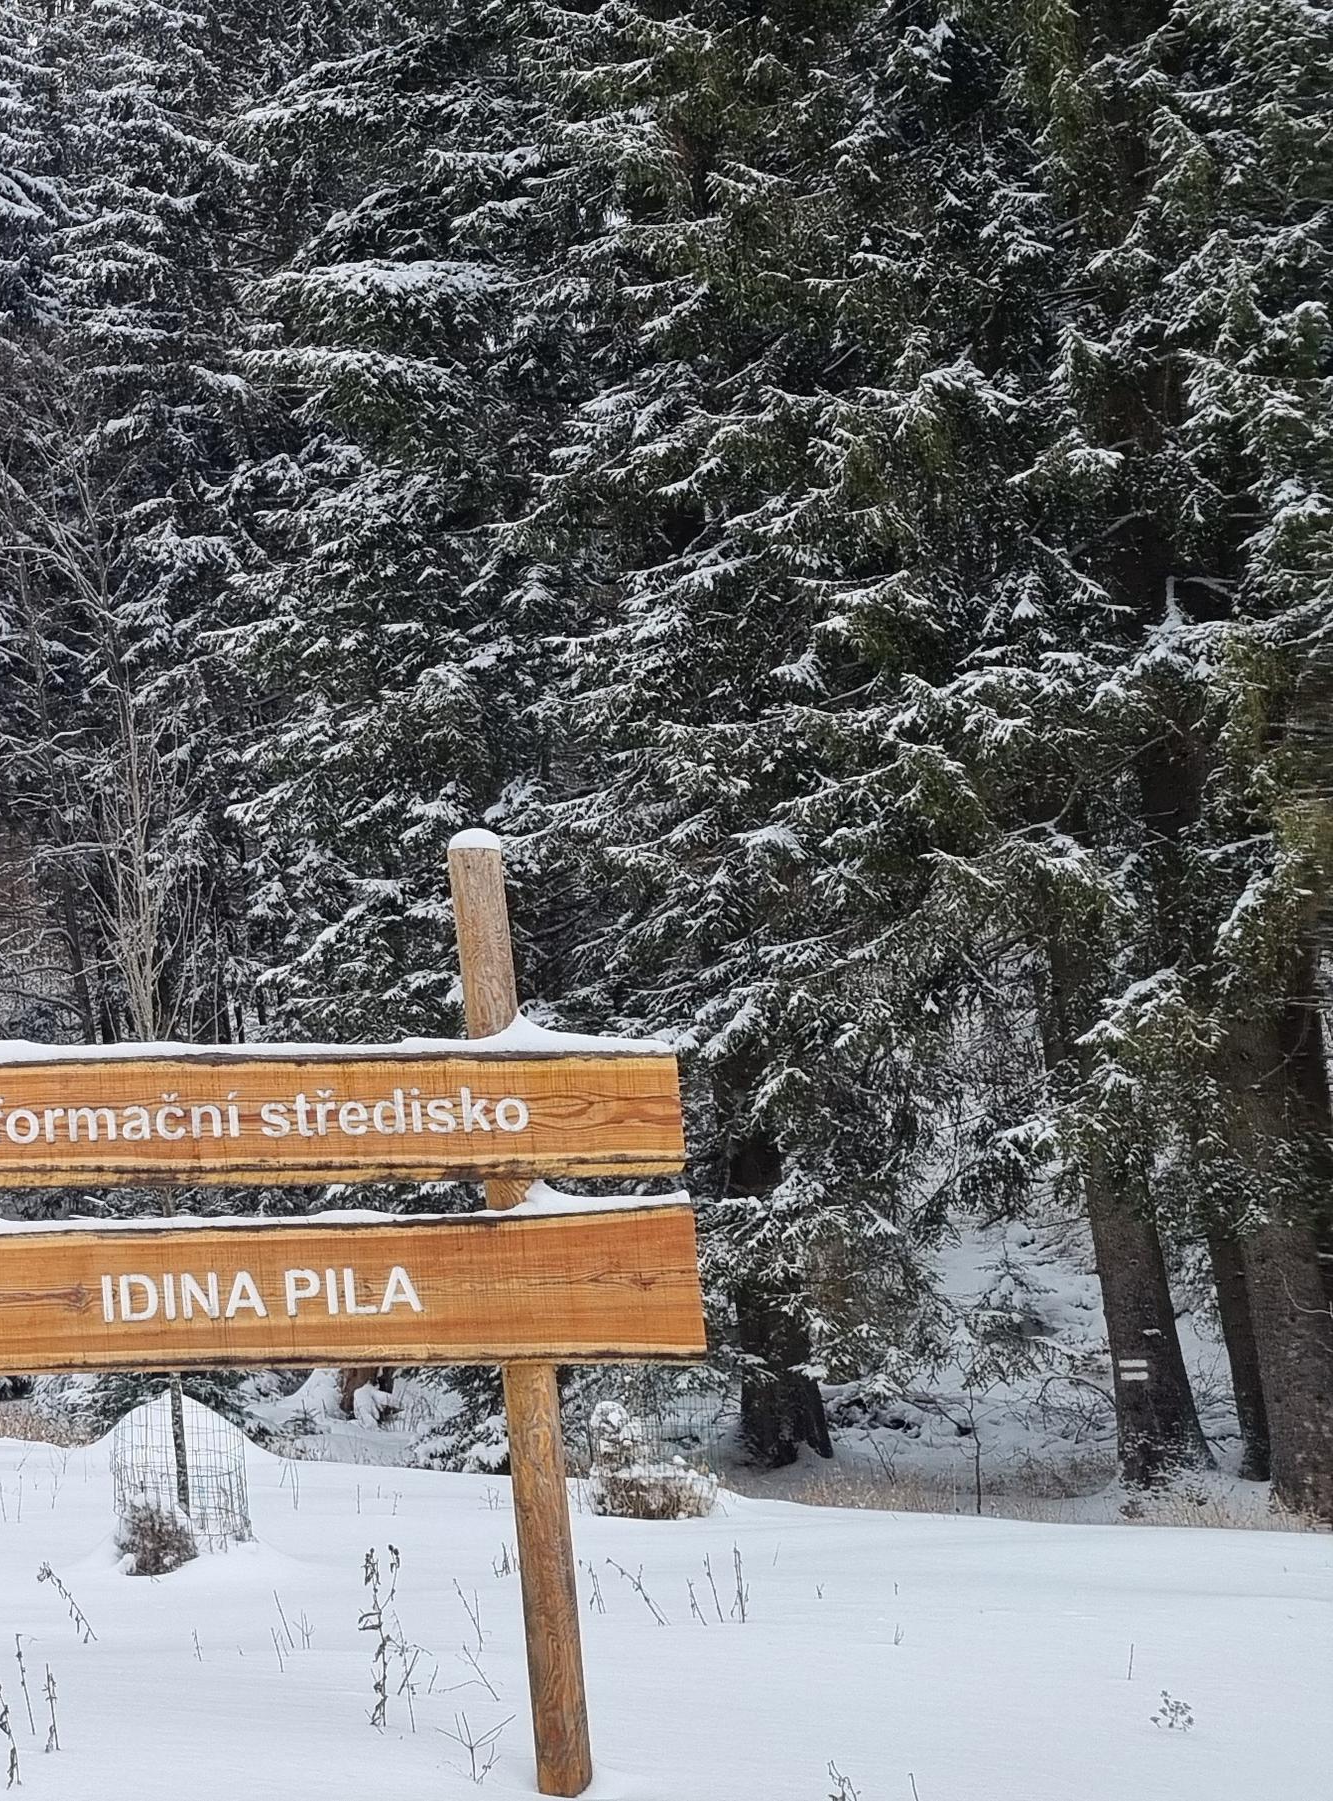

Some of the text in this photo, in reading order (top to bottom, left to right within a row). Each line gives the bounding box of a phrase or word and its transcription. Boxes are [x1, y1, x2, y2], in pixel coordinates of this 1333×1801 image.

[260, 1087, 530, 1138] středisko
[101, 1265, 424, 1323] IDINA PILA
